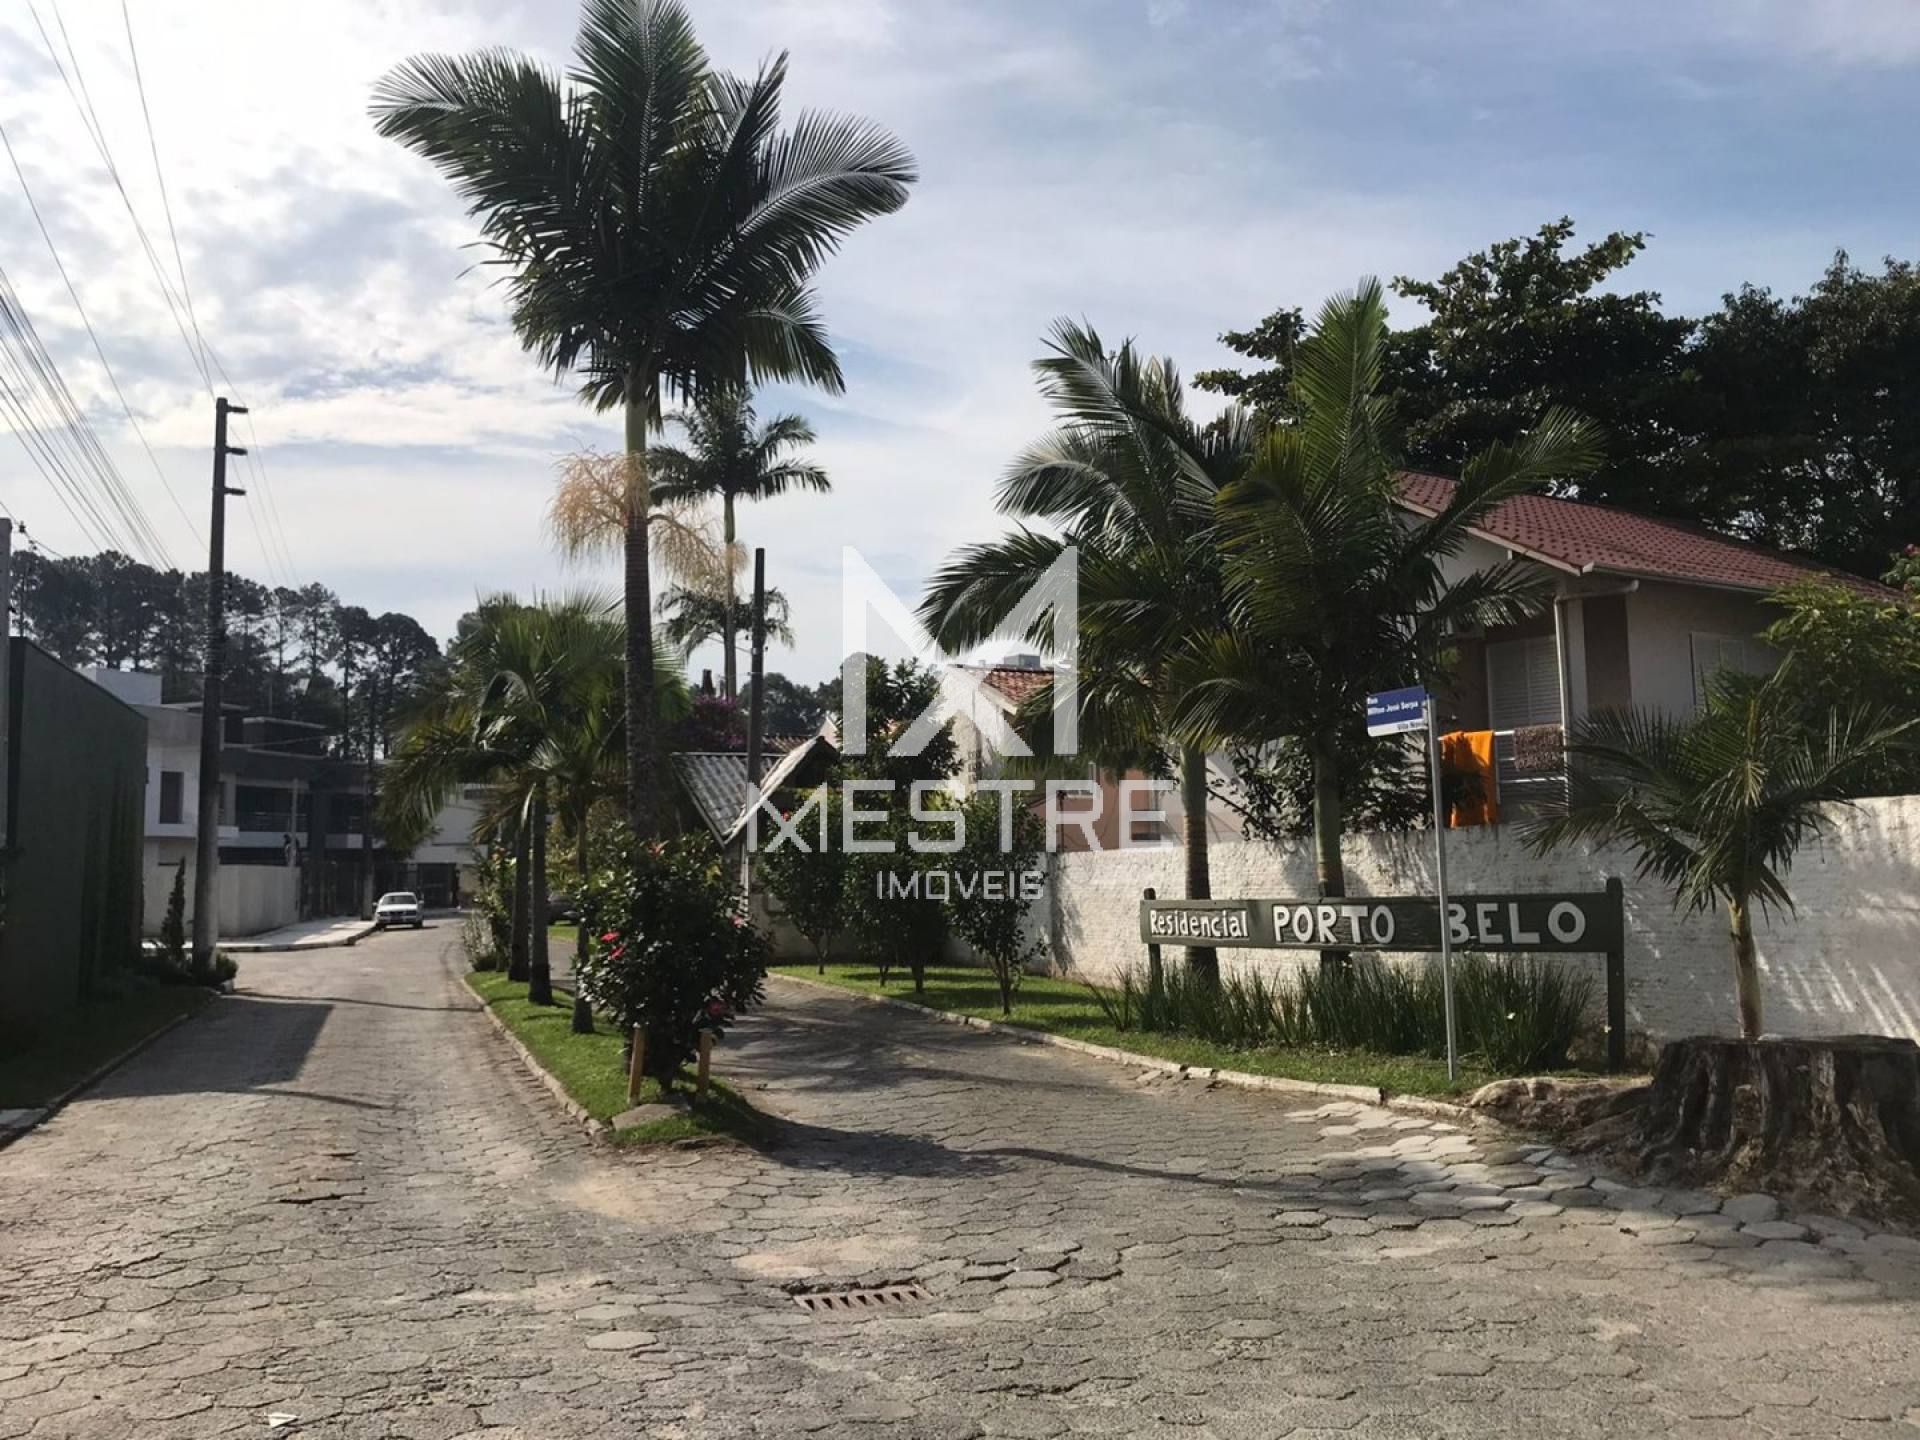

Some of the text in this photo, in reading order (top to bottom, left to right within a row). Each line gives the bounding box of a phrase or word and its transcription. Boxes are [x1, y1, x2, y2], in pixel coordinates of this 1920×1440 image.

[1150, 901, 1586, 944] Residencial PORTO BELO
